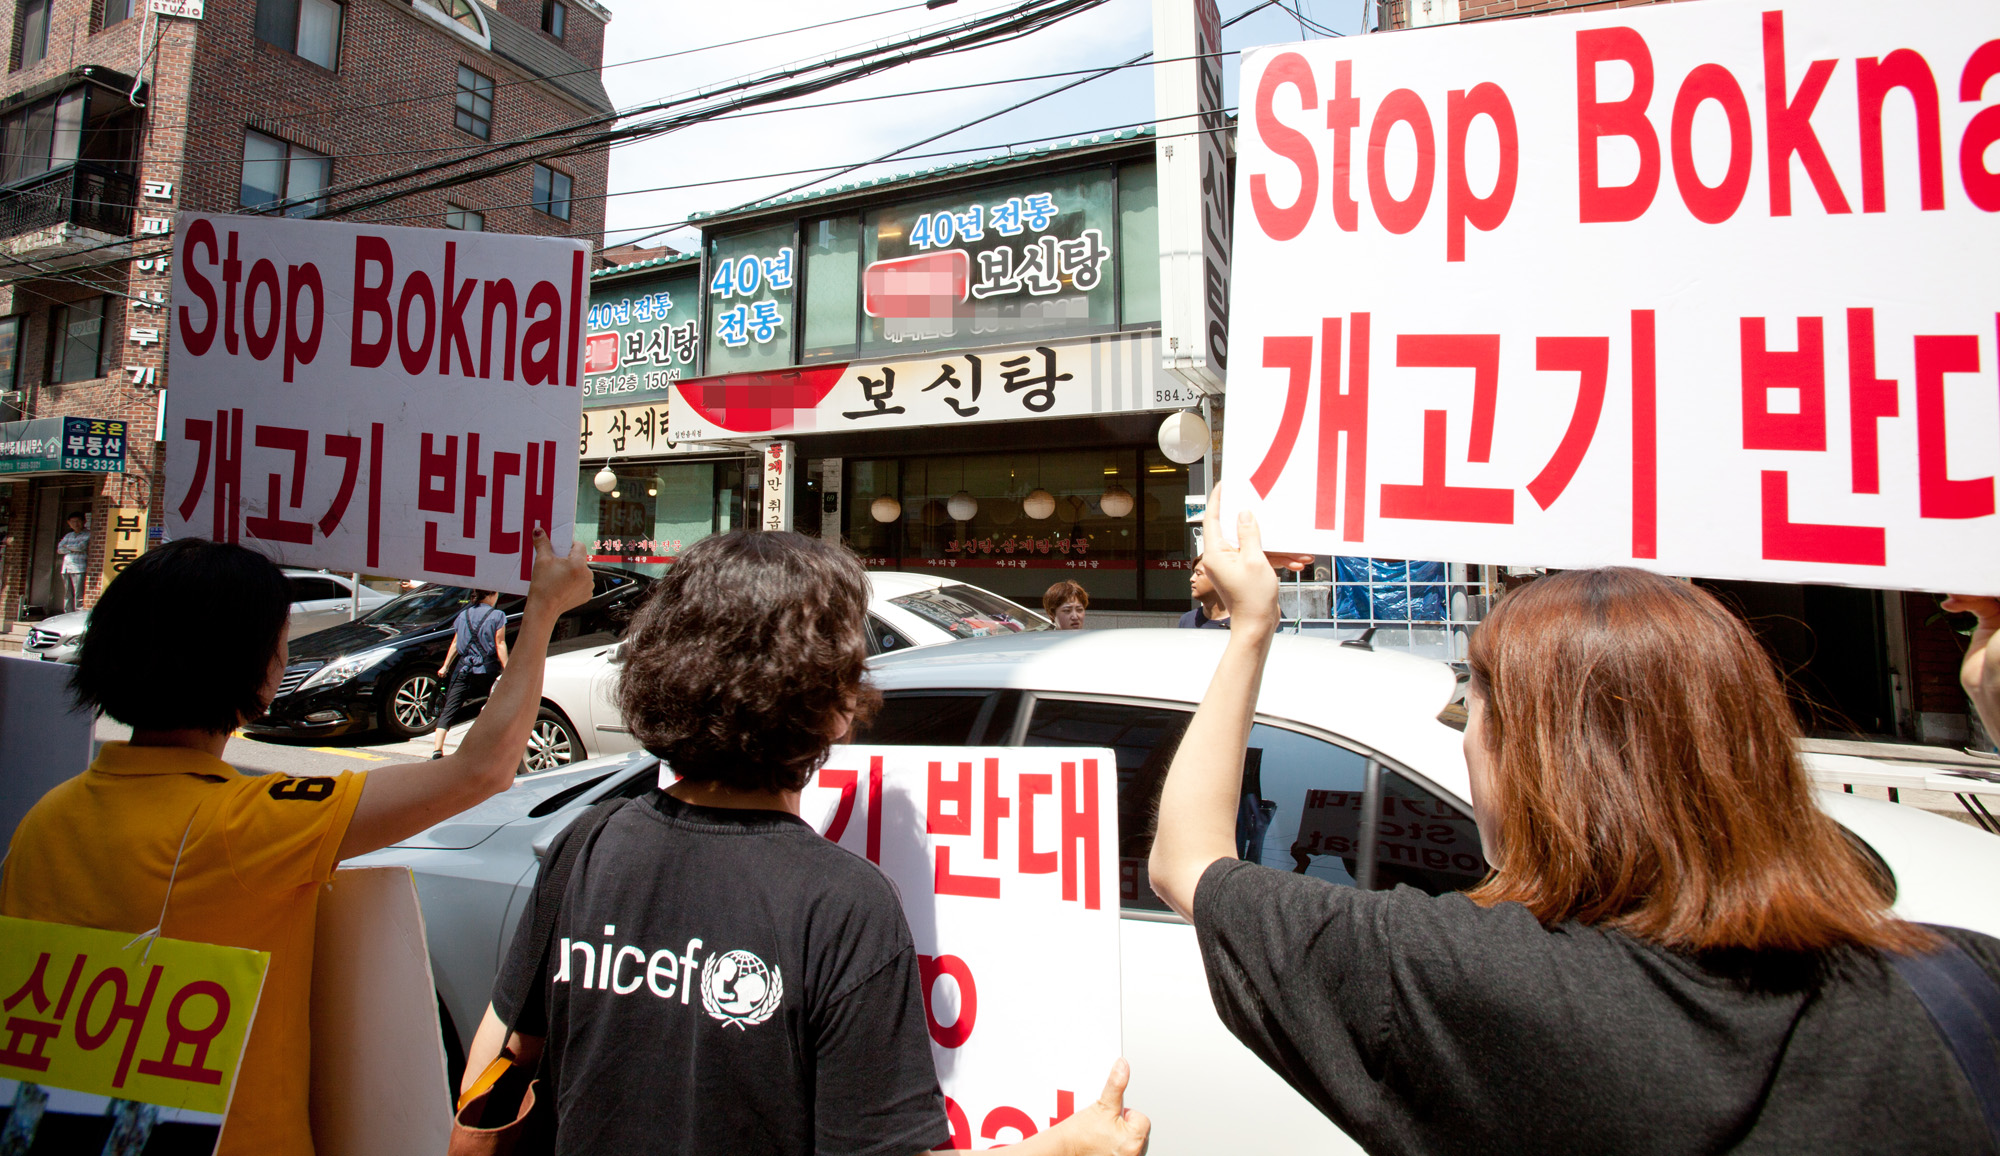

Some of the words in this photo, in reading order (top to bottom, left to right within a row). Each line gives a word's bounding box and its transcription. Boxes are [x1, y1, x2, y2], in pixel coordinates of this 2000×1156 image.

[153, 2, 200, 16] STUDIO
[1250, 52, 1519, 262] Stop
[909, 204, 984, 250] 40년
[990, 192, 1058, 237] 전통
[711, 247, 793, 299] 40년
[971, 229, 1110, 299] 보신탕
[179, 218, 324, 383] Stop
[350, 236, 585, 387] Boknal
[588, 299, 631, 330] 40년
[633, 291, 673, 322] 전통
[716, 300, 784, 347] 전통
[621, 319, 699, 367] 보신탕
[842, 347, 1074, 420] 보신탕
[1156, 388, 1200, 402] 584.3
[67, 435, 121, 457] 부동산
[90, 421, 124, 436] 조은
[1250, 309, 1658, 560] 개고기
[65, 458, 121, 471] 585-3321
[179, 408, 384, 568] 개고기
[418, 433, 557, 581] 반대
[110, 515, 142, 572] 부동
[1054, 538, 1090, 554] 전문
[926, 757, 1101, 910] 반대
[0, 952, 231, 1088] 싶어요
